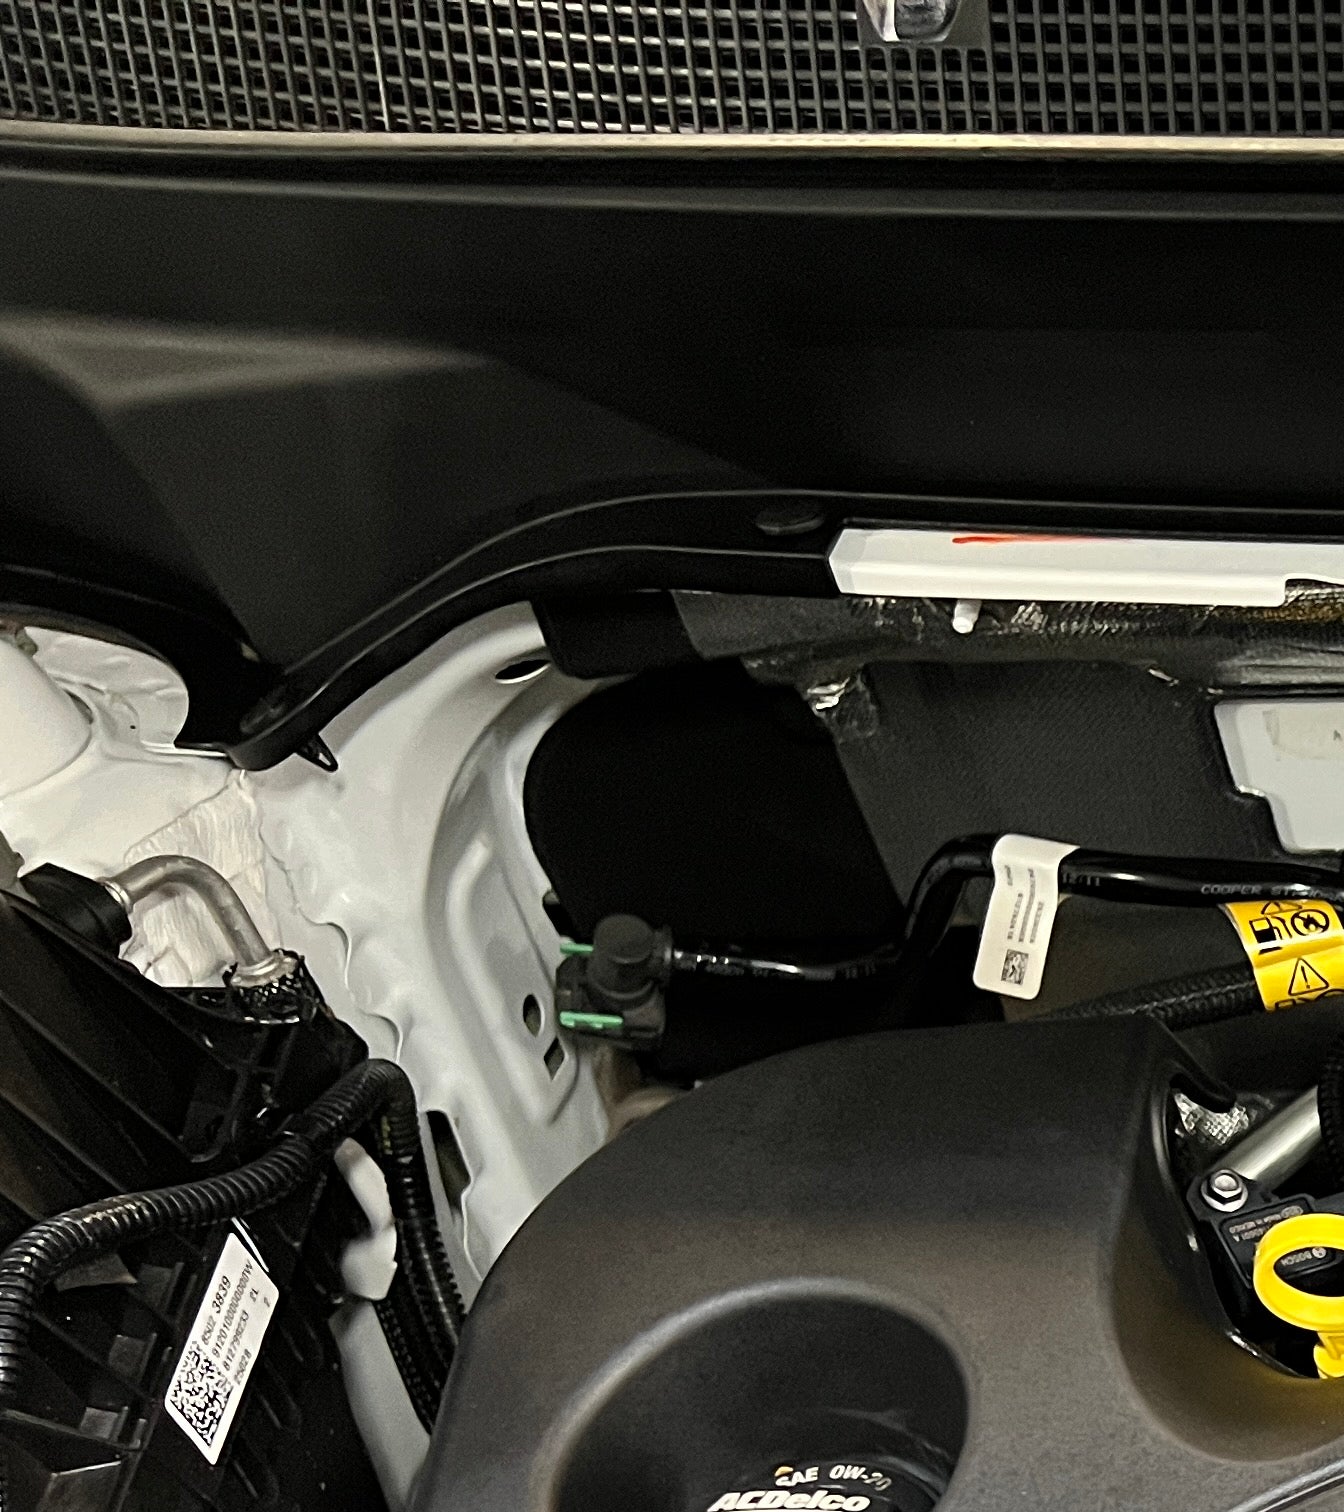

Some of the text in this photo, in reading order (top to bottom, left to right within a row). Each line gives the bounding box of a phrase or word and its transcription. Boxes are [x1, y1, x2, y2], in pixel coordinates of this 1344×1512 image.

[211, 1275, 232, 1315] 3839
[774, 1464, 892, 1492] SAE 0W-20
[707, 1490, 871, 1512] ACDelco
